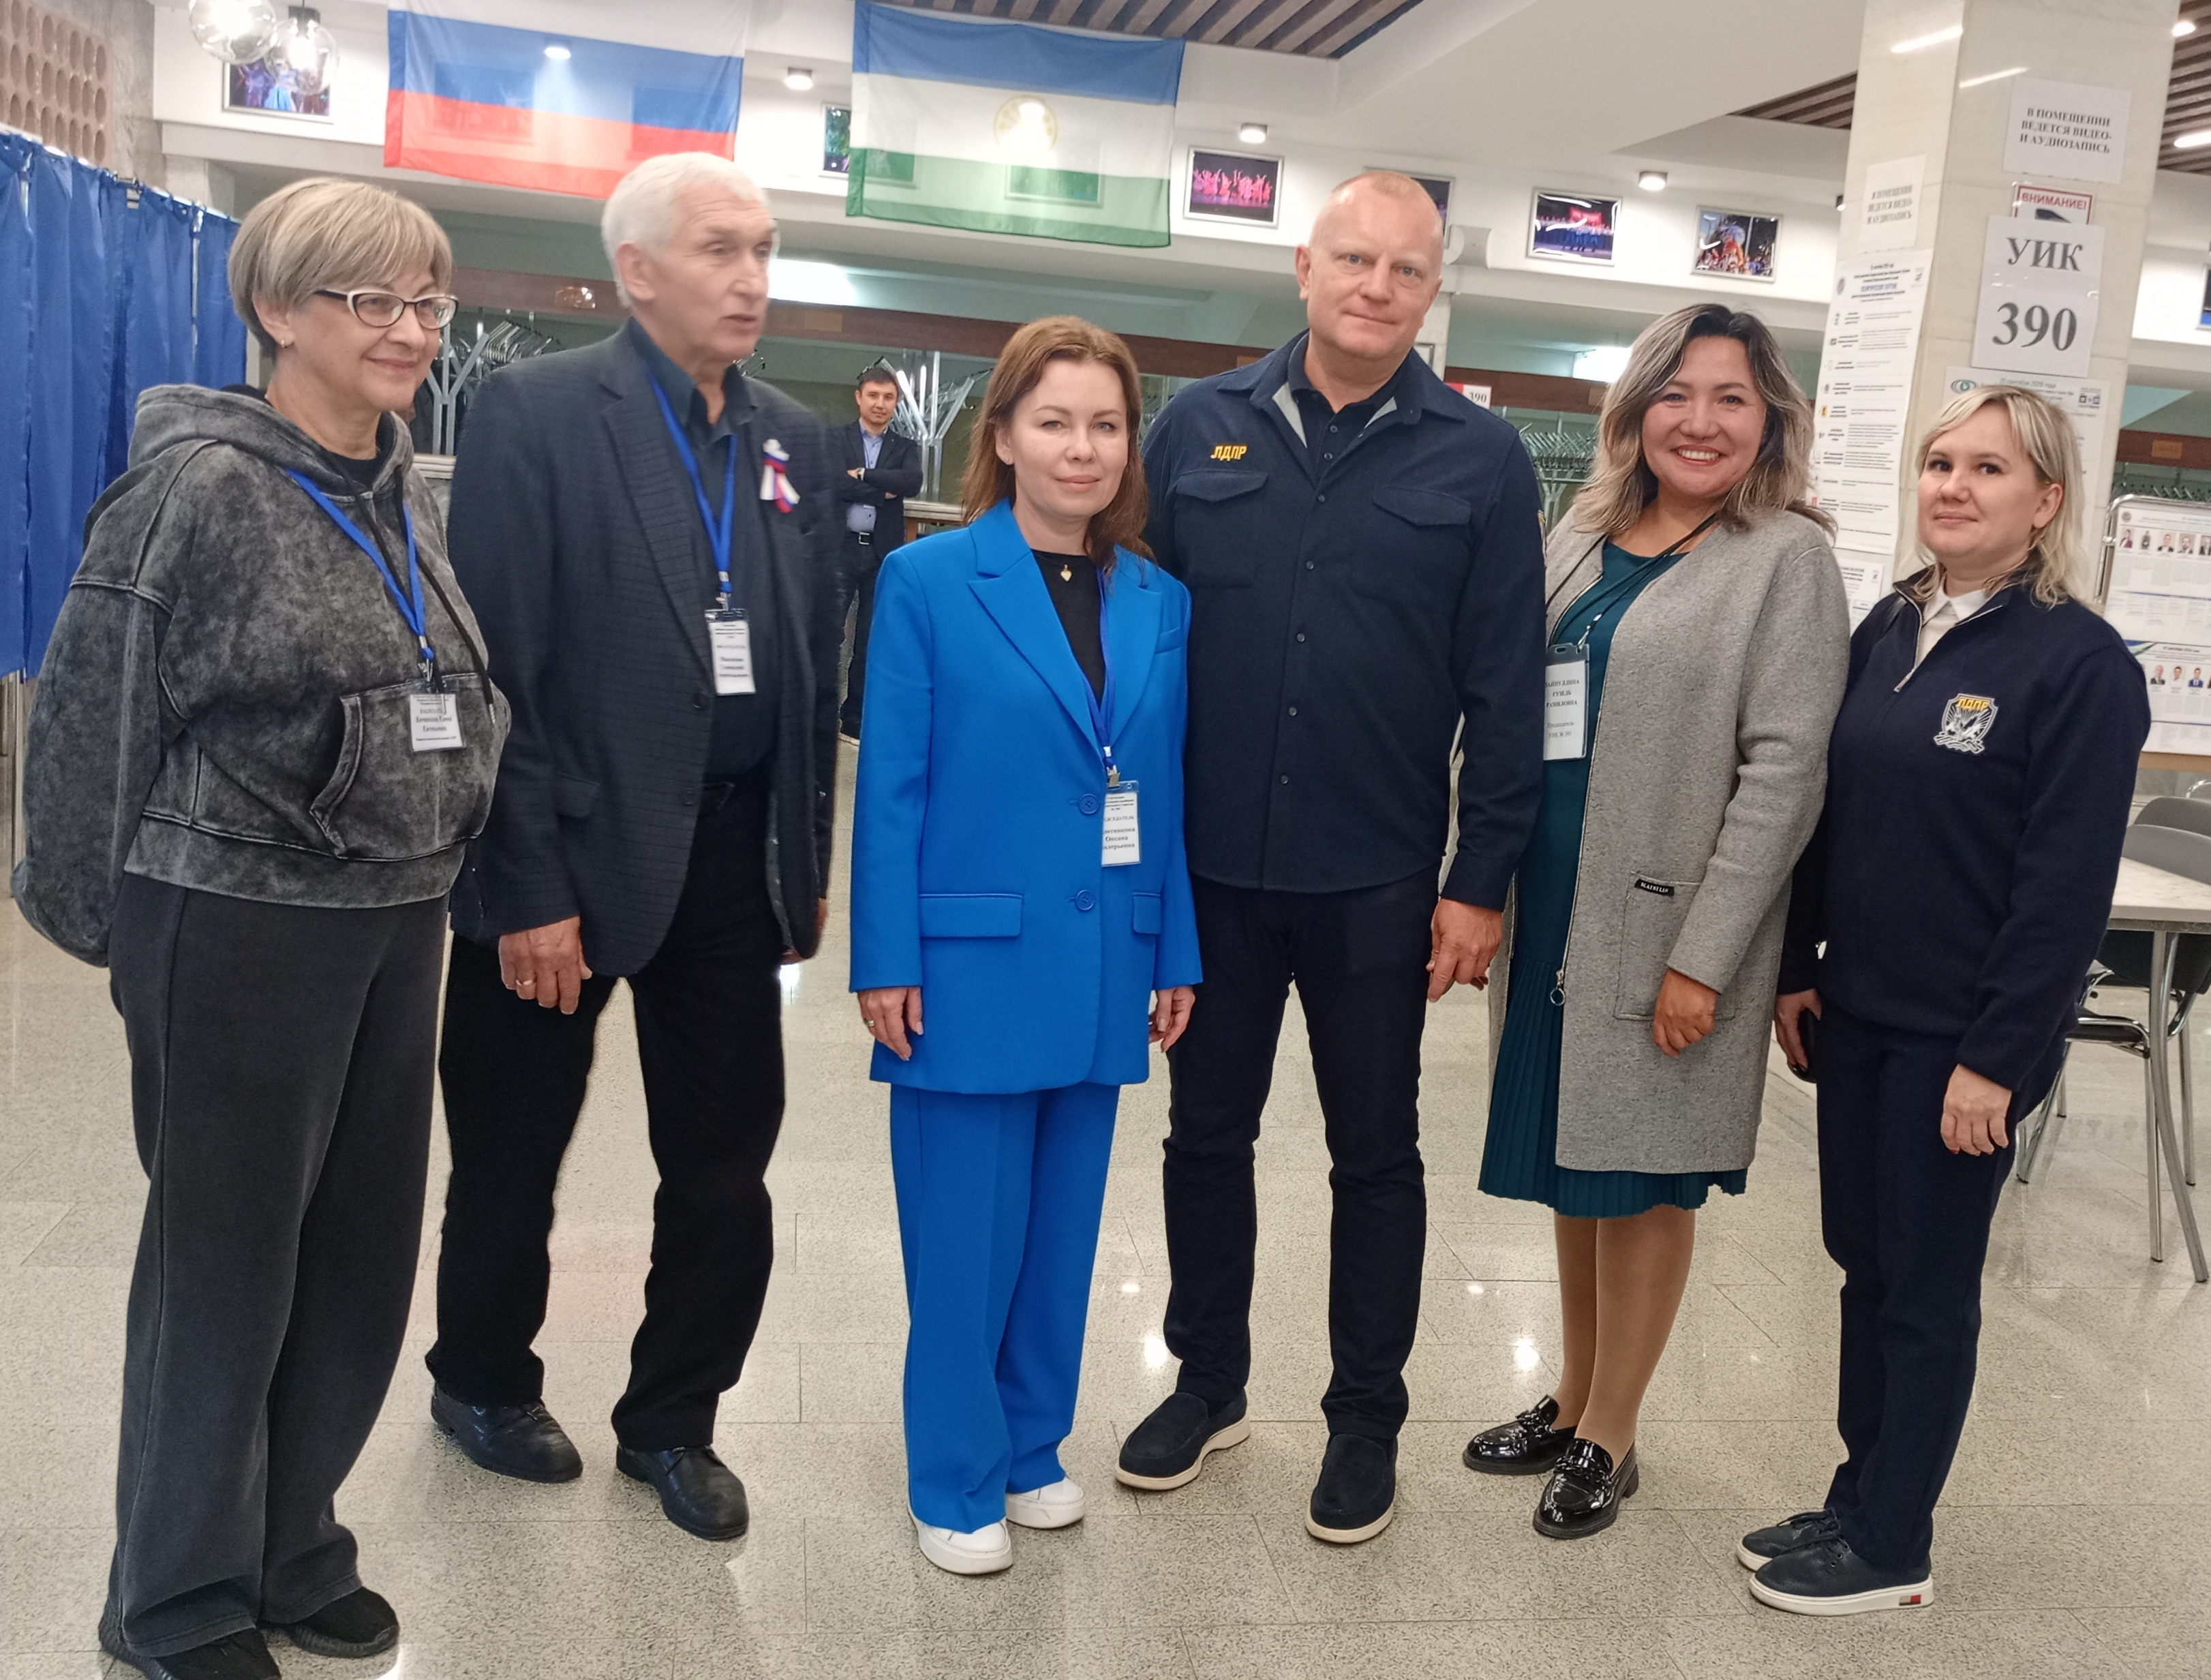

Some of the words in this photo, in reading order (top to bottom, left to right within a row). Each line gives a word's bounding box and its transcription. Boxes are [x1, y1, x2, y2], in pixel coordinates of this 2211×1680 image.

[2027, 108, 2034, 117] В
[2036, 108, 2110, 127] ПОМЕЩЕНИИ
[2021, 120, 2071, 136] ВЕДЕТСЯ
[2073, 126, 2112, 140] ВИДЕО-
[2019, 134, 2028, 143] И
[2030, 135, 2110, 154] АУДИОЗАПИСЬ
[2022, 192, 2088, 211] ВНИМАНИЕ!
[2006, 237, 2084, 272] УИК
[1992, 302, 2077, 351] 390
[1469, 392, 1487, 403] 390
[1210, 445, 1247, 461] ЛДПР
[1955, 697, 1990, 712] ЛДПР
